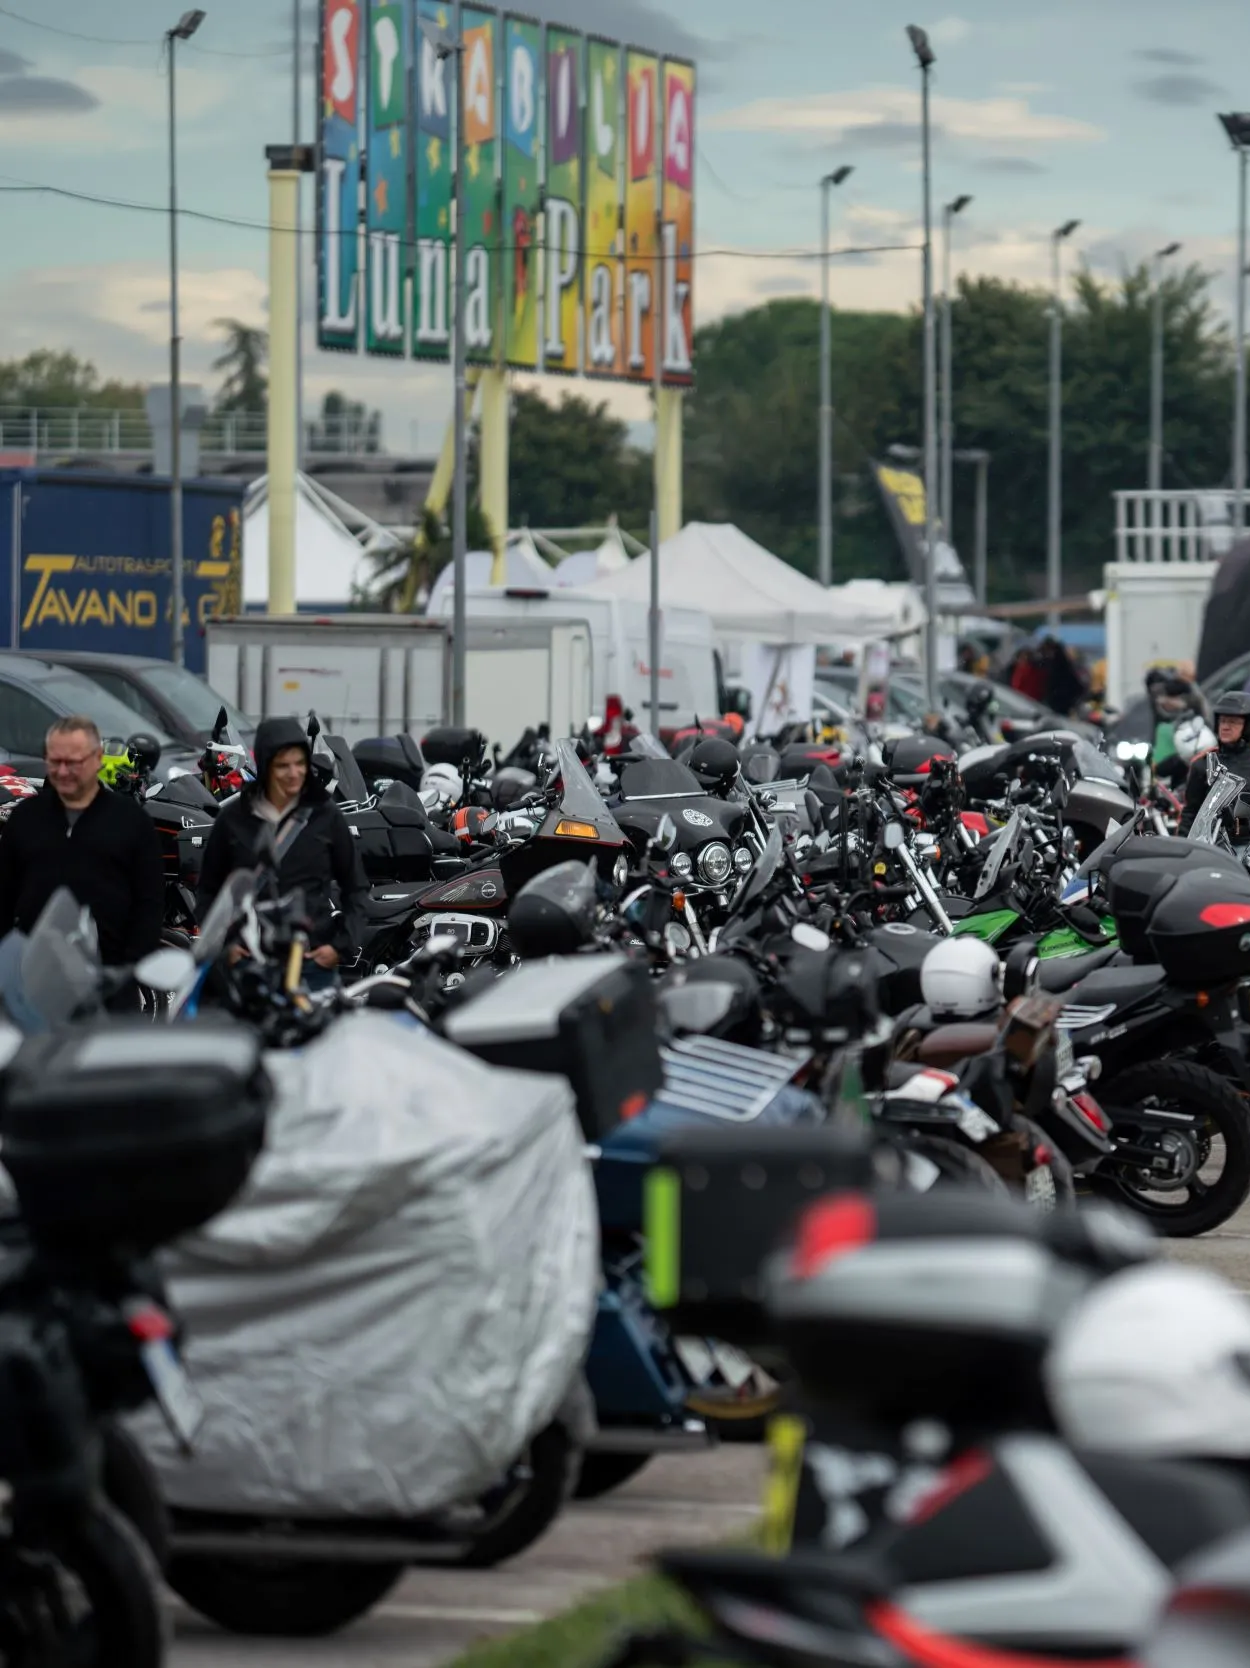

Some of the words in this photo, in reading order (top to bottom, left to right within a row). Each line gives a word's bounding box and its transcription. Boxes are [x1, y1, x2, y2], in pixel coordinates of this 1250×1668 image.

[322, 158, 492, 348] Luna
[546, 197, 691, 373] Park
[22, 554, 158, 630] TAVANO
[76, 554, 197, 576] AUTOTRASPOTI
